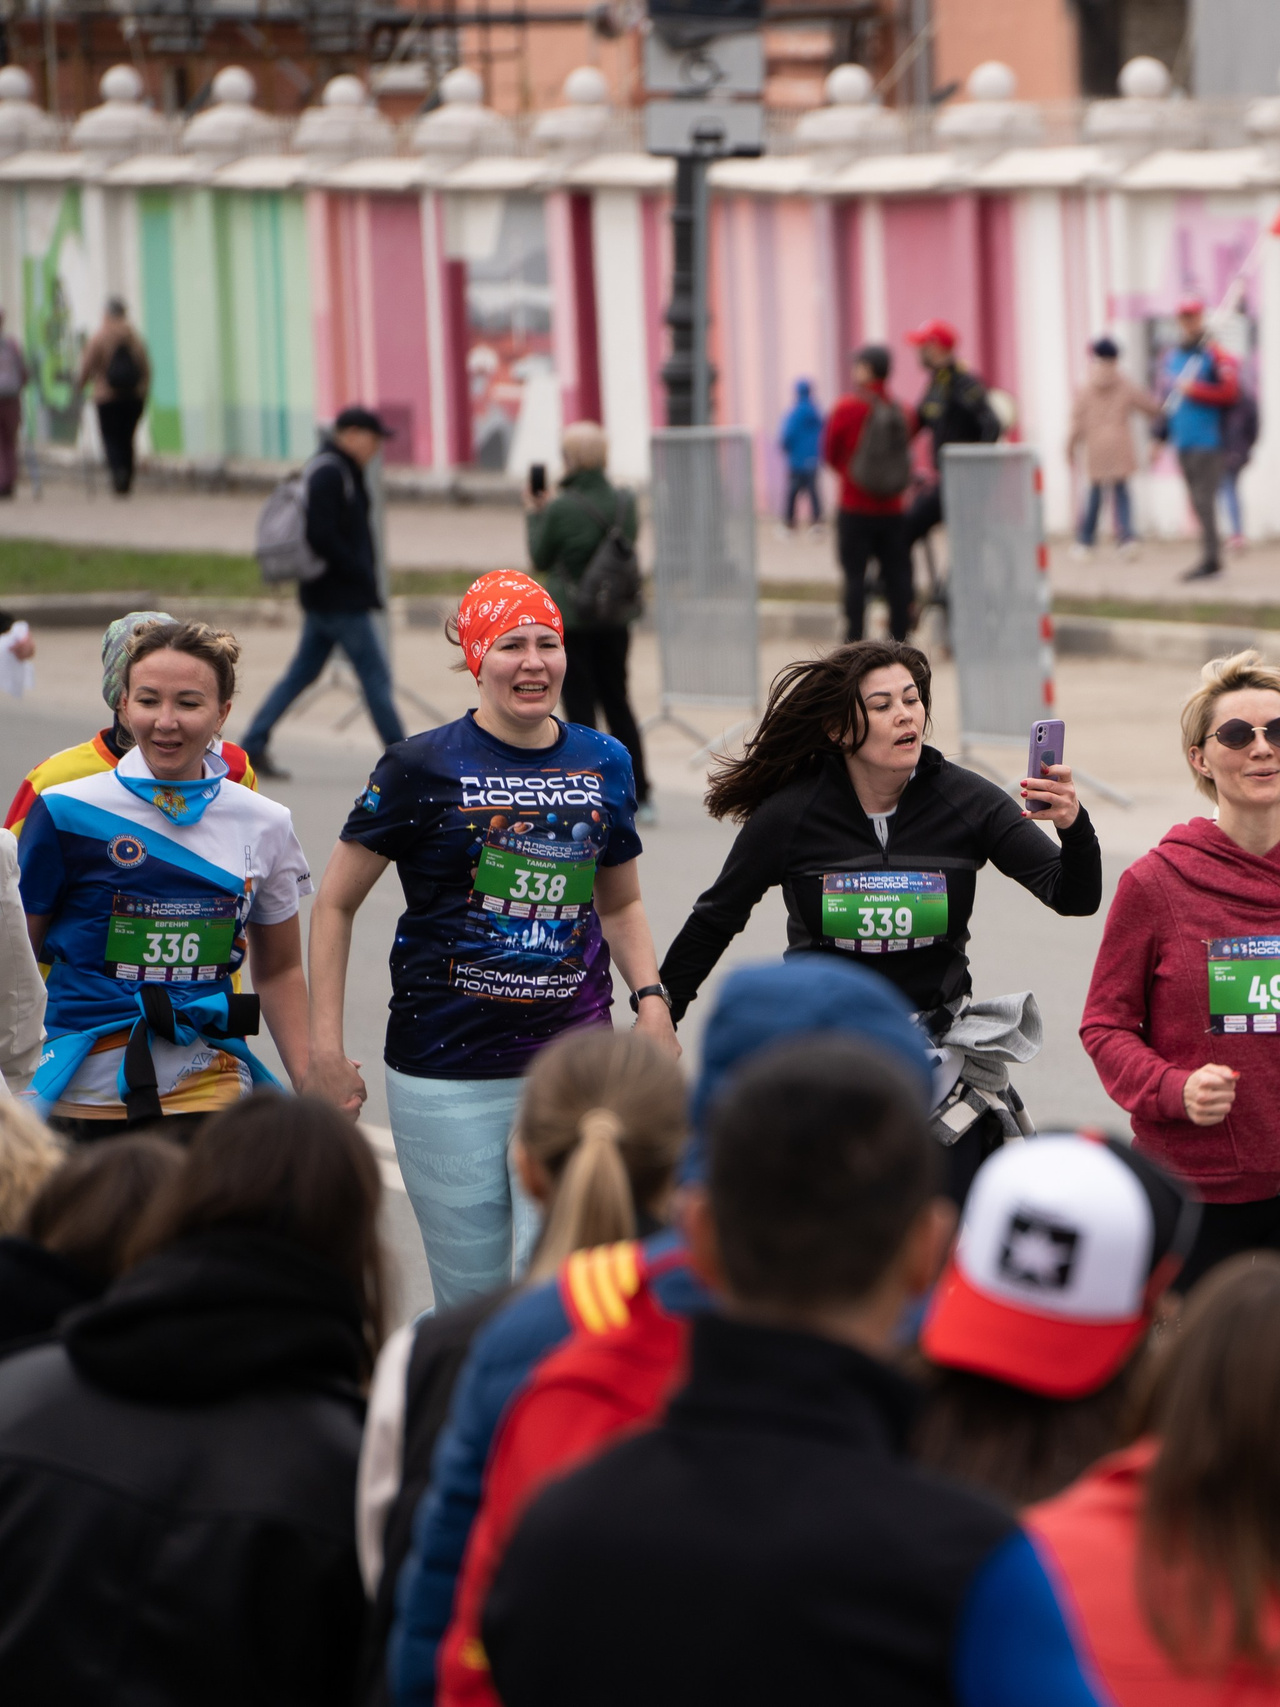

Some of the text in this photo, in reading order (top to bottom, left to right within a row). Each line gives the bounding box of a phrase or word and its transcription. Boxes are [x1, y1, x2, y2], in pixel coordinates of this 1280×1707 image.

[490, 598, 508, 622] ОДК
[499, 600, 522, 628] КУЗНЕЦОВ
[460, 774, 600, 790] Я ПРОСТО
[462, 790, 602, 807] КОСМОС
[522, 846, 571, 858] КОСМОС
[532, 842, 572, 852] ПРОСТО
[526, 859, 557, 870] ТАМАРА
[509, 868, 567, 902] 338
[151, 908, 200, 916] КОСМОС
[858, 907, 913, 937] 339
[142, 932, 200, 963] 336
[456, 964, 587, 986] КОСМИЧЕСКИЙ
[38, 1049, 55, 1068] EN
